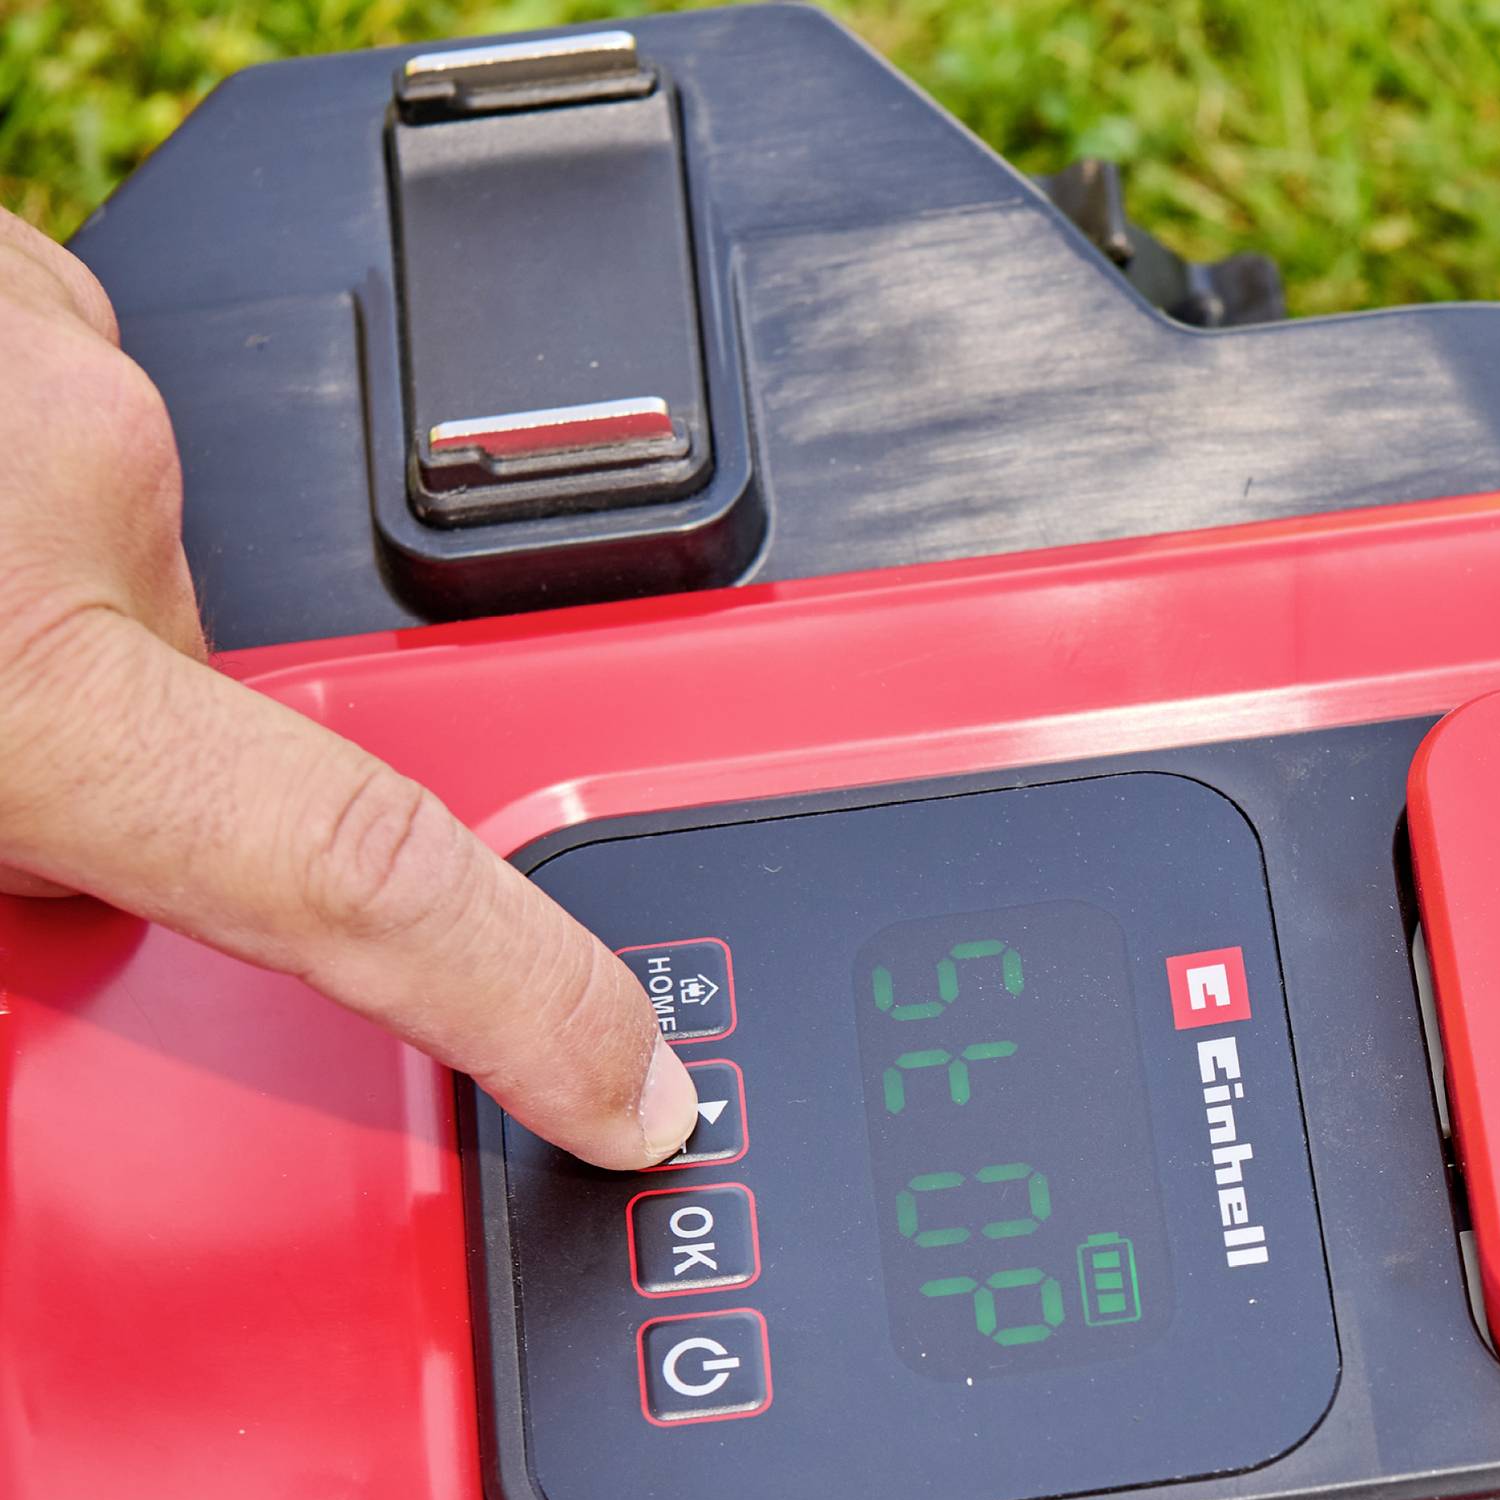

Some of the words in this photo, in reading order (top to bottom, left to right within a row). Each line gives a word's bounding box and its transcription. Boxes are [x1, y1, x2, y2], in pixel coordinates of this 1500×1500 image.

[647, 956, 677, 1033] HOME
[1196, 1036, 1269, 1268] Einhell
[667, 1205, 718, 1277] OK
